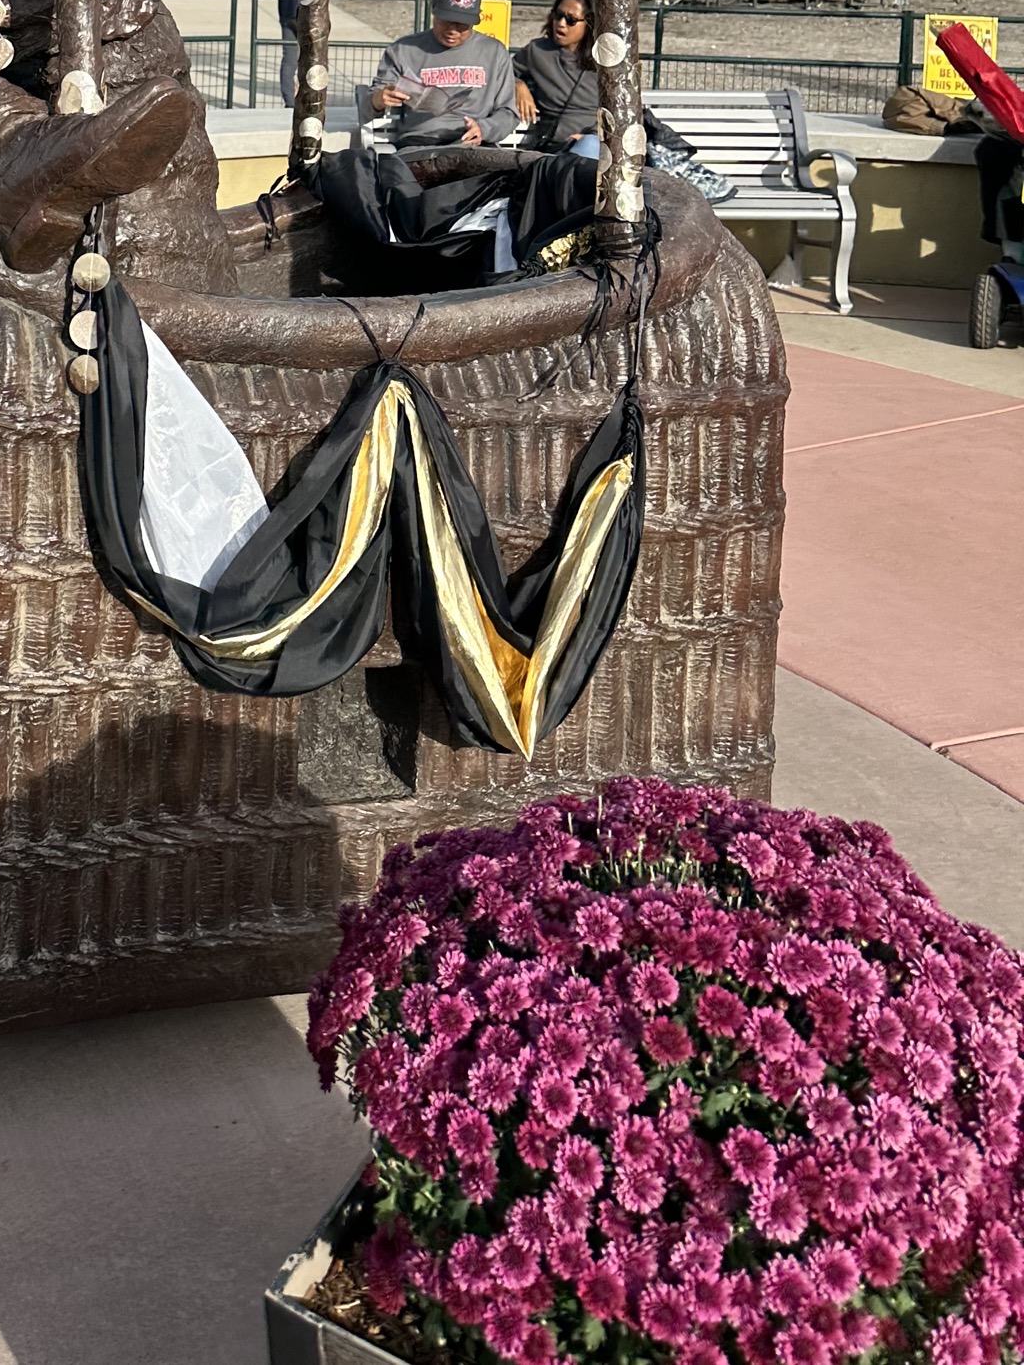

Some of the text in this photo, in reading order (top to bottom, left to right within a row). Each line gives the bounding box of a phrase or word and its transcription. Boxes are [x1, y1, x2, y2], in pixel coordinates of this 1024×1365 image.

[420, 69, 486, 86] TEAM 413
[930, 80, 951, 90] THIS
